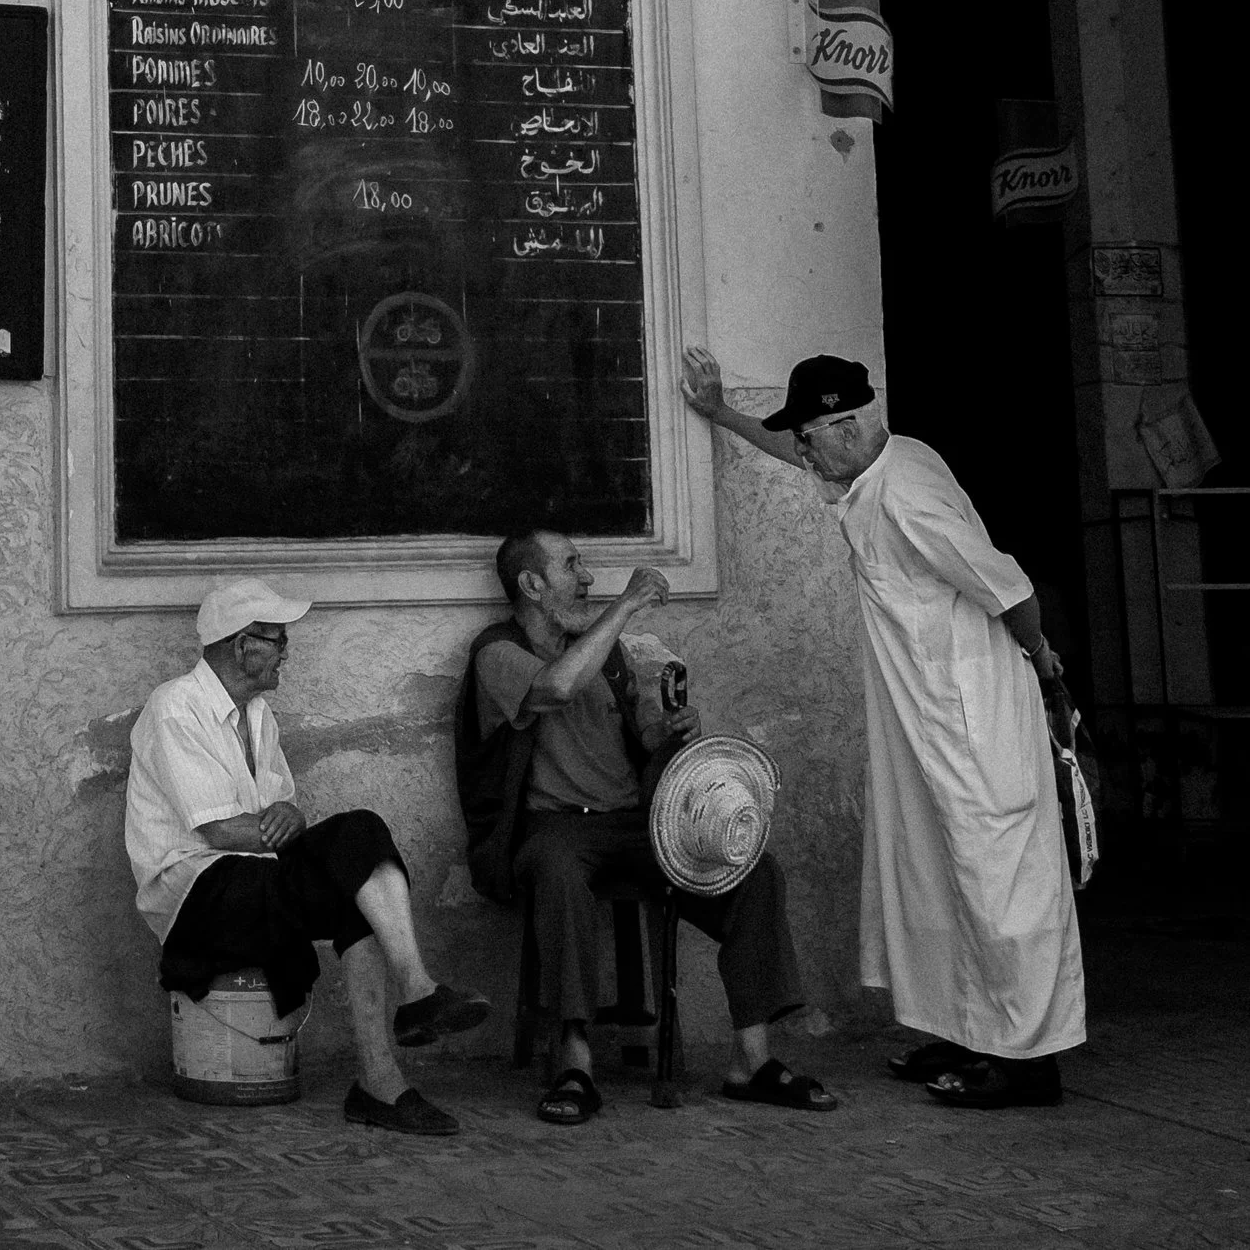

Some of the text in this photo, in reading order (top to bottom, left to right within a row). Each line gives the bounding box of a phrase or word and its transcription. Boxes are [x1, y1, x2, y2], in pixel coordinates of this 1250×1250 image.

[811, 27, 890, 75] Knorr
[132, 54, 218, 88] POMMES
[300, 58, 346, 92] 10,00
[403, 67, 451, 102] 10,00
[132, 97, 201, 127] POIRES
[292, 98, 348, 130] 18,00
[405, 106, 454, 134] 18,00
[131, 180, 212, 210] PRUNES
[351, 178, 413, 213] 18,00
[996, 164, 1073, 200] Knorr
